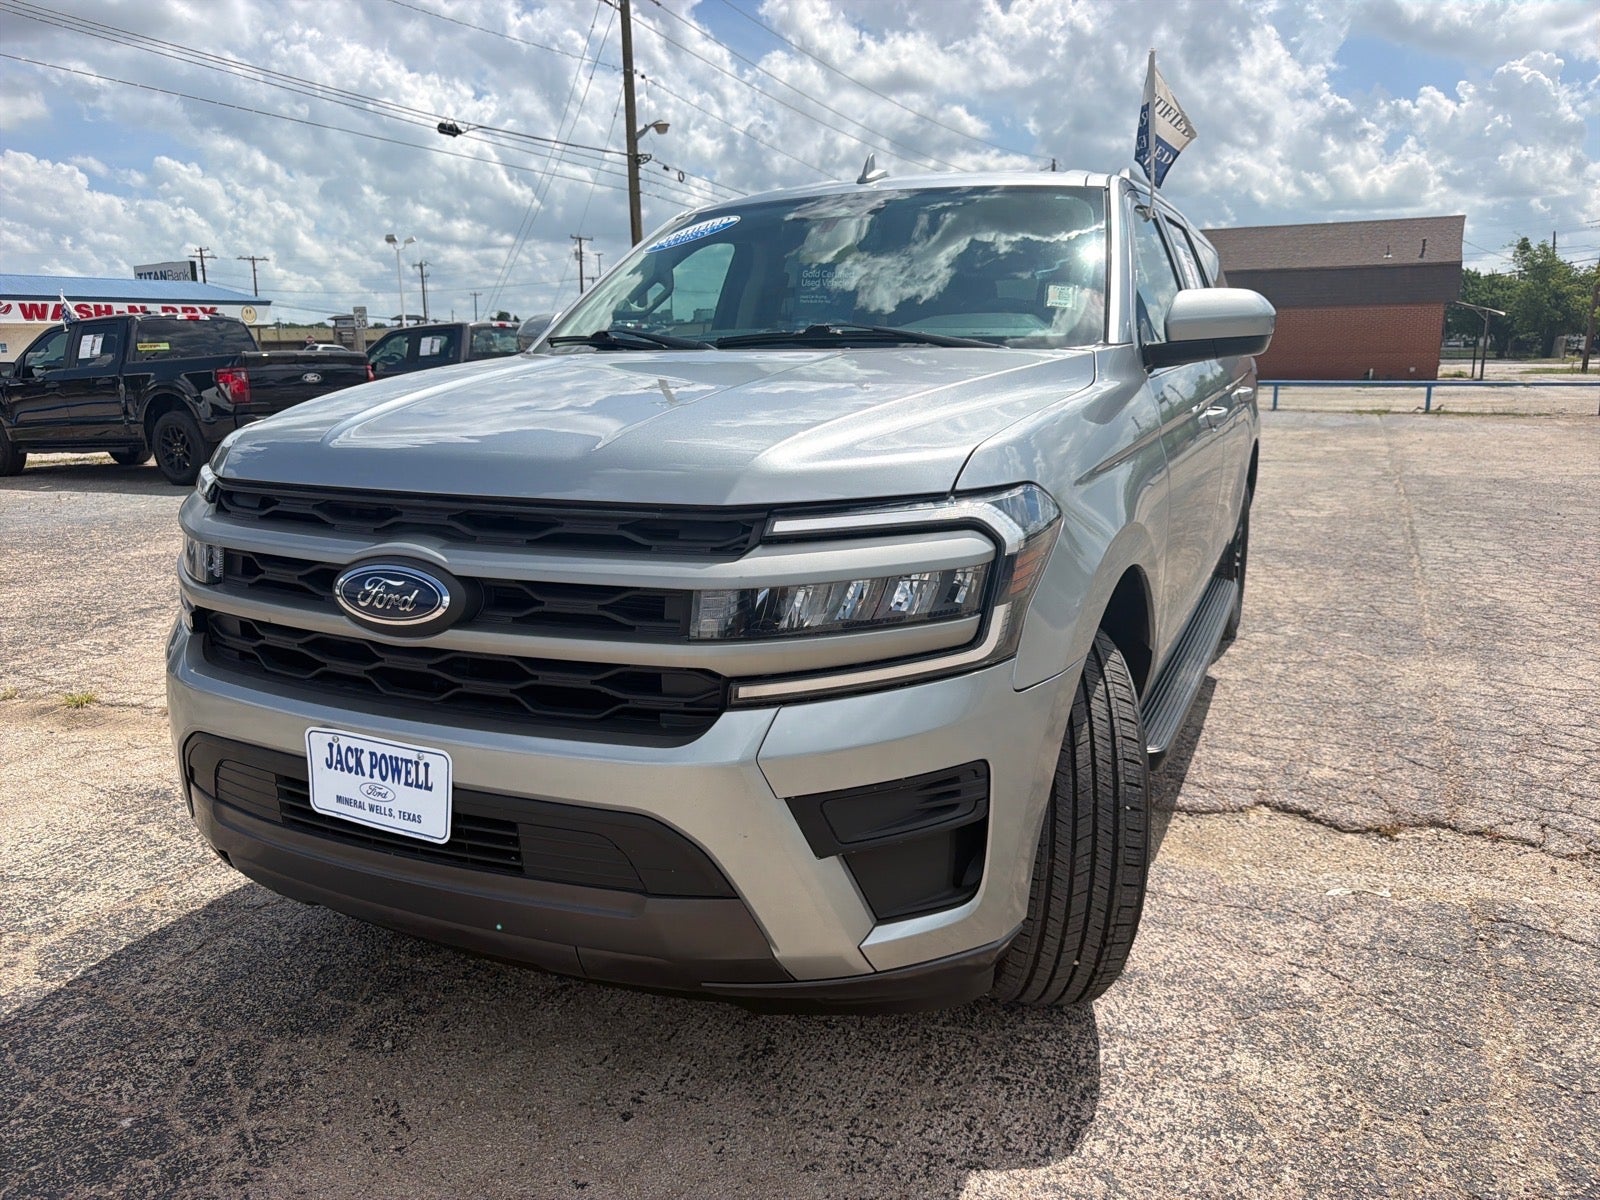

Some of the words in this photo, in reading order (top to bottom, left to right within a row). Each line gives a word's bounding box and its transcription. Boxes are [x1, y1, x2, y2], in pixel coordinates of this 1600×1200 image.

[801, 278, 821, 287] Used
[802, 270, 820, 278] Gold
[18, 302, 218, 321] WASH-NDRY
[357, 576, 419, 612] Ford
[325, 742, 366, 777] JACK
[369, 751, 433, 792] POWELL
[366, 784, 389, 800] Ford
[336, 794, 366, 811] MINERAL
[368, 803, 396, 820] WELLS,
[398, 810, 422, 824] TEXAS
